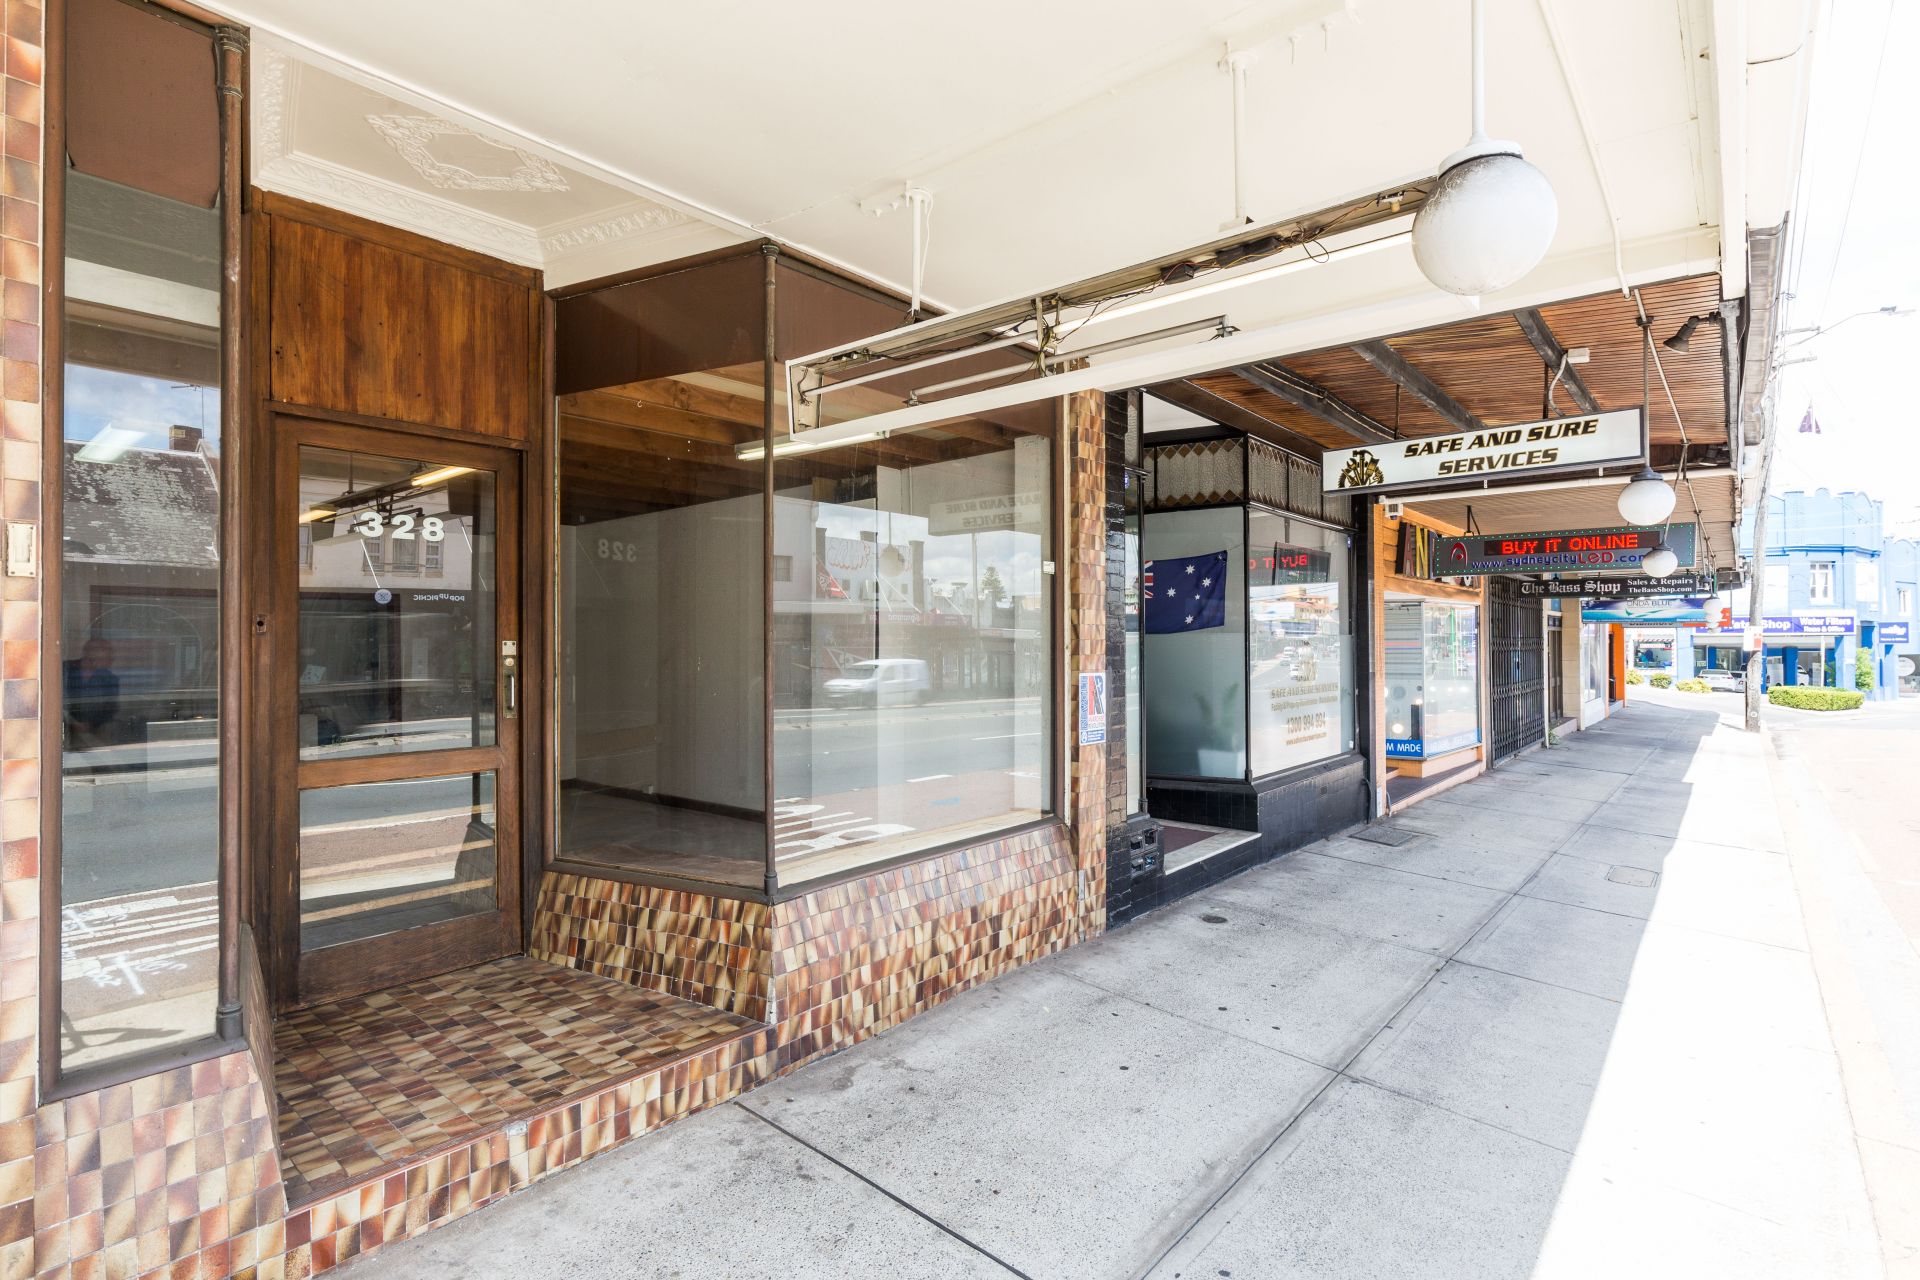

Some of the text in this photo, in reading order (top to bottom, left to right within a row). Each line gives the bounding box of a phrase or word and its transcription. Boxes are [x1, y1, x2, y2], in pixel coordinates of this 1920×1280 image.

[1403, 418, 1599, 458] SAFE AND SURE
[1437, 447, 1559, 475] SERVICES
[359, 511, 445, 541] 328
[1501, 534, 1638, 555] BUY IT ONLINE
[1521, 580, 1621, 596] The Bass Shop
[1660, 577, 1693, 586] Repairs
[1628, 586, 1692, 594] TheBassShop.com
[1761, 619, 1791, 630] Shop
[1800, 616, 1825, 626] Water
[1396, 742, 1422, 753] MADE
